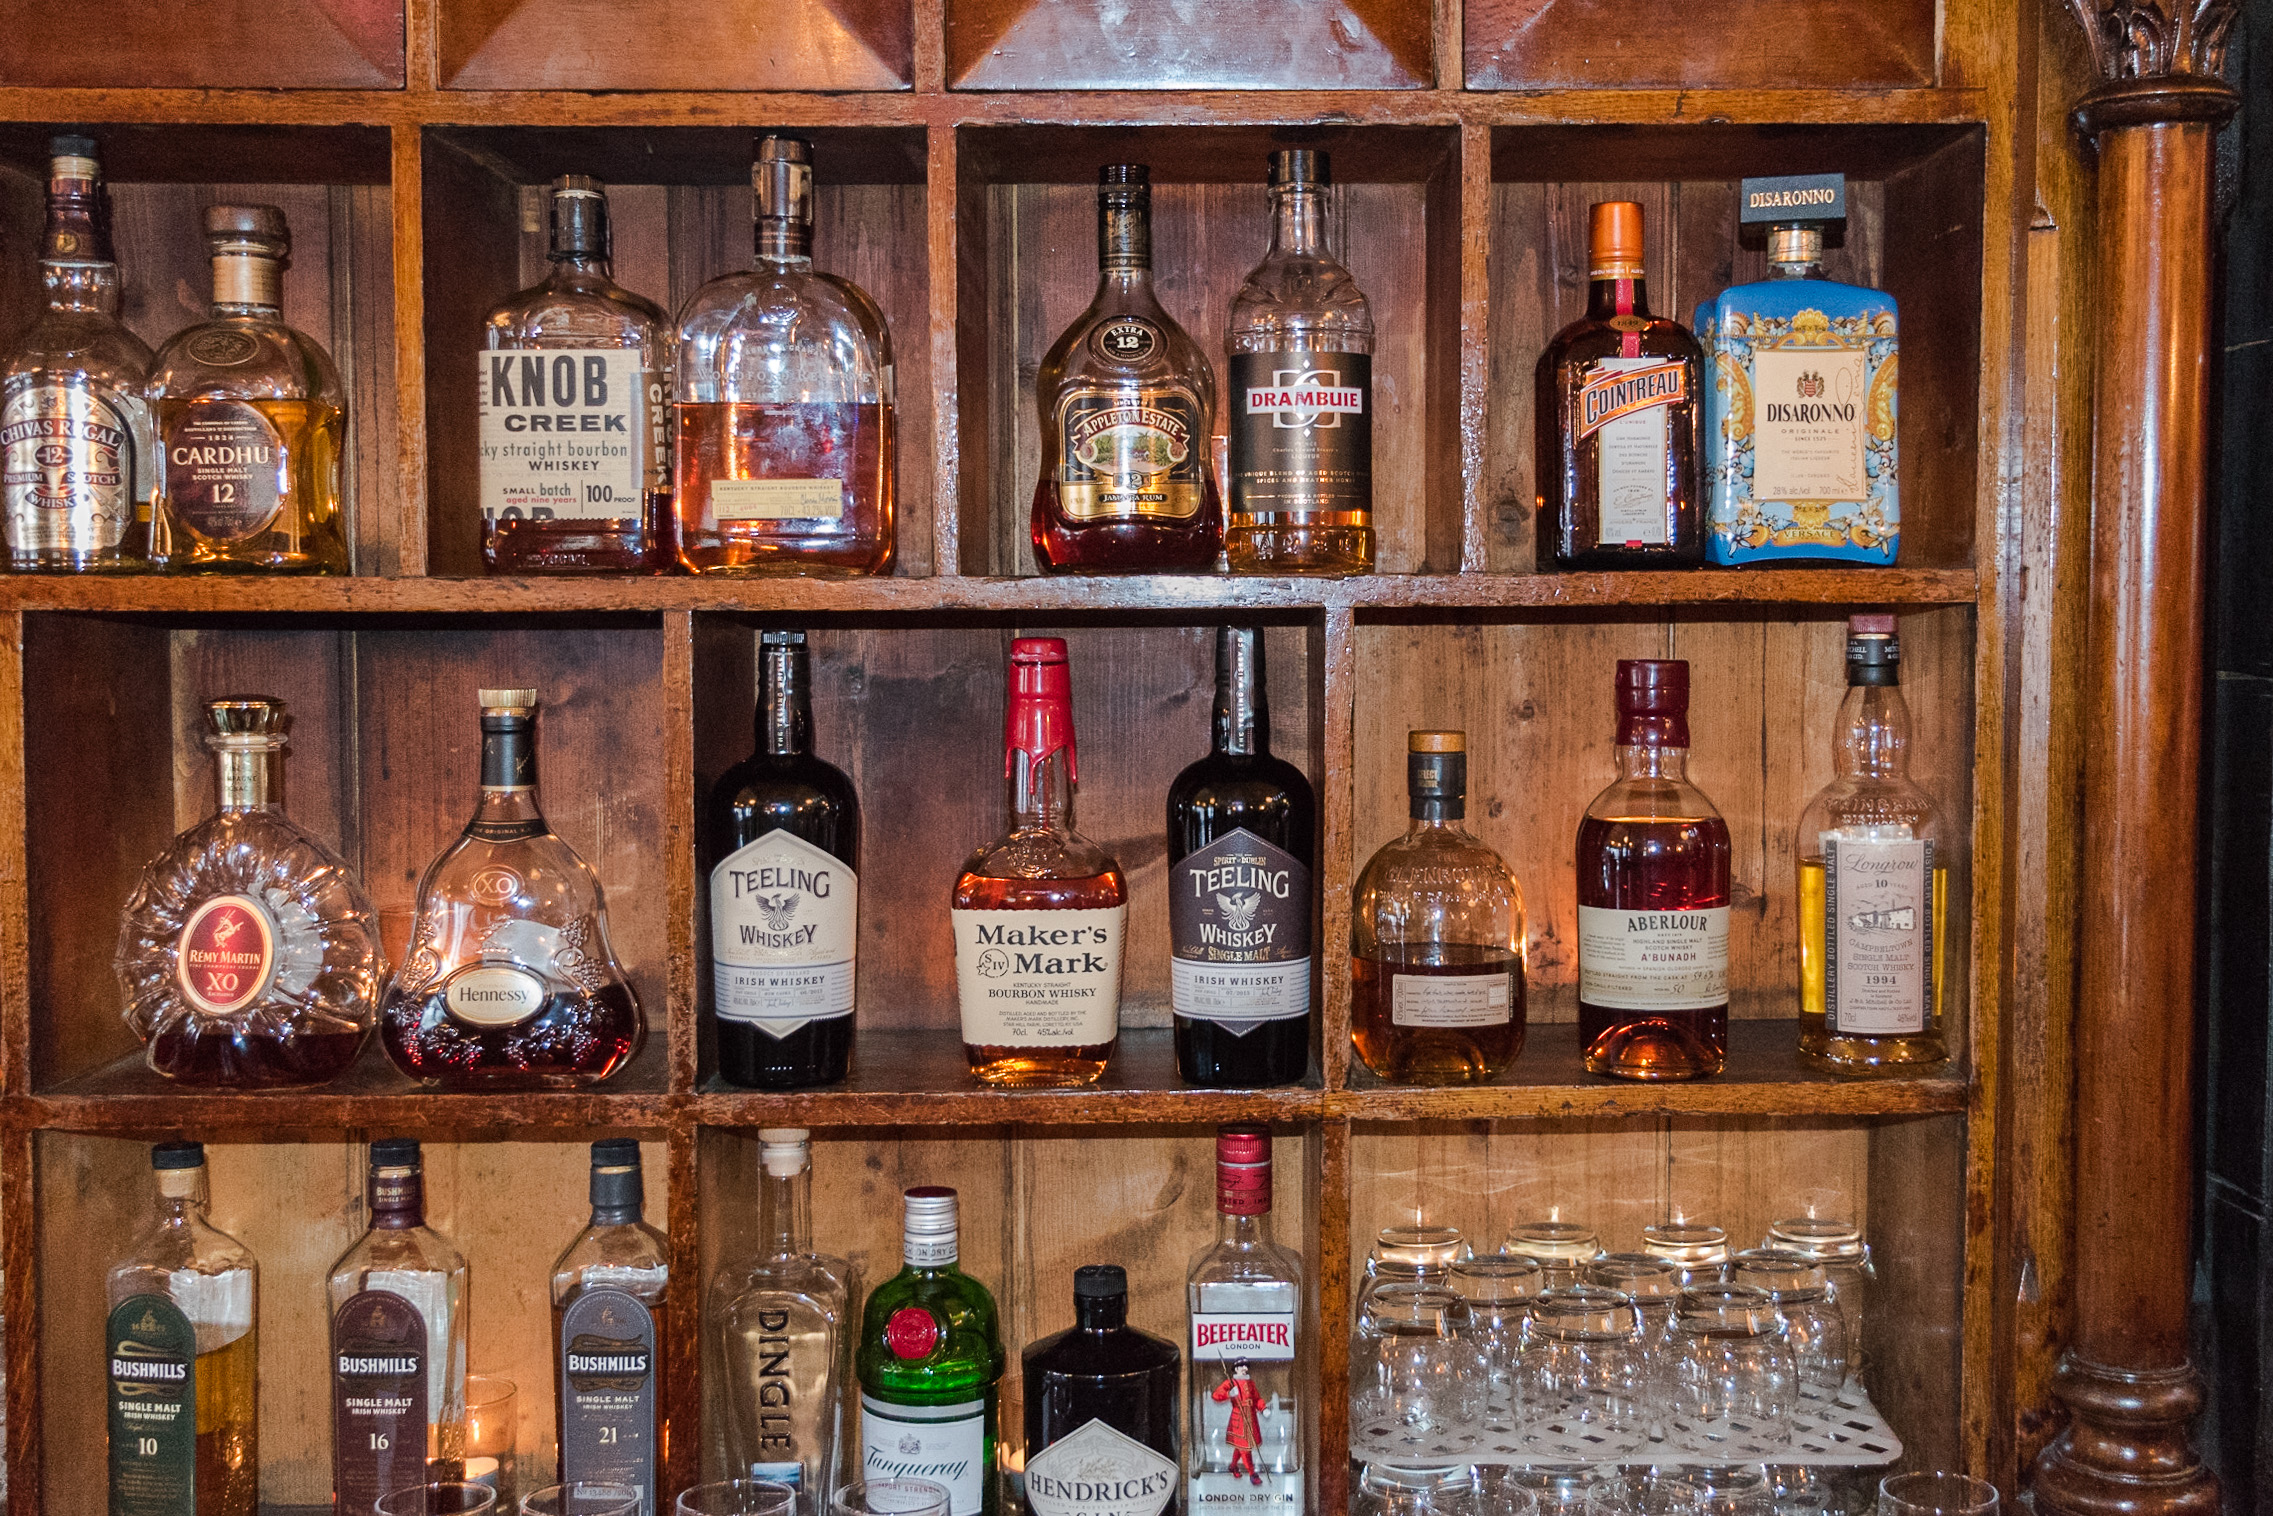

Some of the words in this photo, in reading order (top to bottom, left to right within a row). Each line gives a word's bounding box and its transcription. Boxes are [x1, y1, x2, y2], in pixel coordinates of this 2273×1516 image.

[1750, 189, 1835, 208] DISARONNO
[1111, 326, 1144, 336] EXTRA
[1116, 336, 1139, 348] 12
[491, 355, 608, 408] KNOB
[698, 369, 789, 381] WOODFOD
[1252, 392, 1358, 408] DRAMBUIE
[1586, 370, 1678, 424] COINTREAU
[1767, 403, 1855, 424] DISARONNO
[504, 414, 627, 432] CREEK
[1083, 411, 1140, 437] APPLETON
[1142, 410, 1180, 436] ESTATE
[1, 420, 53, 445] CHIVAS
[59, 421, 119, 447] RGAL
[44, 446, 63, 464] 12
[172, 446, 270, 466] CARDHU
[503, 440, 562, 460] straight
[568, 440, 628, 457] bourbon
[529, 461, 600, 471] WHISKEY
[4, 473, 43, 483] PREMIUM
[213, 483, 235, 503] 12
[540, 482, 571, 497] batch
[586, 485, 613, 503] 100
[506, 496, 528, 505] aged
[531, 496, 550, 504] nine
[553, 496, 577, 505] years
[1784, 530, 1836, 538] VERSACE
[1213, 856, 1237, 866] SPIRIT
[1241, 856, 1267, 865] DUBLIN
[1827, 848, 1836, 874] MALT
[1843, 853, 1919, 876] Longrow
[729, 867, 831, 898] TEELING
[1190, 866, 1290, 899] TEELING
[1876, 880, 1888, 888] 10
[1924, 848, 1933, 905] DISTILLERY
[1827, 877, 1836, 913] SINGLE
[1627, 914, 1708, 932] ABERLOUR
[740, 924, 818, 948] WHISKEY
[975, 924, 1108, 945] Maker's
[1199, 923, 1278, 948] WHISKEY
[1827, 917, 1836, 960] BOTTLED
[1208, 946, 1243, 961] SINGLE
[1244, 946, 1271, 961] MALT
[1849, 939, 1913, 953] CAMPBELTOWN
[190, 949, 219, 963] RÉMY
[221, 950, 261, 965] MARTIN
[1013, 952, 1107, 974] Mark
[1641, 952, 1697, 962] A'BUNADH
[1853, 953, 1883, 961] SINGLE
[1885, 954, 1910, 962] MALT
[1847, 963, 1879, 971] SCOTCH
[1881, 963, 1914, 971] WHISKY
[1924, 956, 1932, 992] SINGLE
[206, 972, 239, 991] XO
[735, 976, 765, 986] IRISH
[770, 975, 825, 986] WHISKEY
[1194, 975, 1225, 985] IRISH
[1230, 975, 1285, 985] WHISKEY
[1866, 975, 1897, 985] 1994
[460, 987, 529, 1004] Hennessy
[989, 989, 1046, 998] BOURBON
[1049, 988, 1097, 998] WHISKY
[1827, 964, 1836, 1021] DISTILLERY
[1197, 1323, 1290, 1348] BEEFEATER
[112, 1359, 186, 1379] BUSHMILLS
[339, 1357, 417, 1374] BUSHMILLS
[568, 1355, 647, 1372] BUSHMILLS
[759, 1307, 792, 1450] DINGLE
[118, 1401, 153, 1412] SINGLE
[154, 1404, 182, 1413] MALT
[346, 1398, 382, 1407] SINGLE
[385, 1398, 413, 1407] MALT
[124, 1412, 142, 1420] IRISH
[143, 1412, 176, 1421] WHISKEY
[370, 1433, 389, 1450] 16
[598, 1427, 618, 1443] 21
[138, 1438, 158, 1455] 10
[866, 1445, 969, 1481] Tanqueray
[1031, 1469, 1168, 1501] HENDRICK'S
[1199, 1493, 1245, 1502] LONDON
[1250, 1493, 1271, 1502] DRY
[1274, 1493, 1294, 1502] GIN
